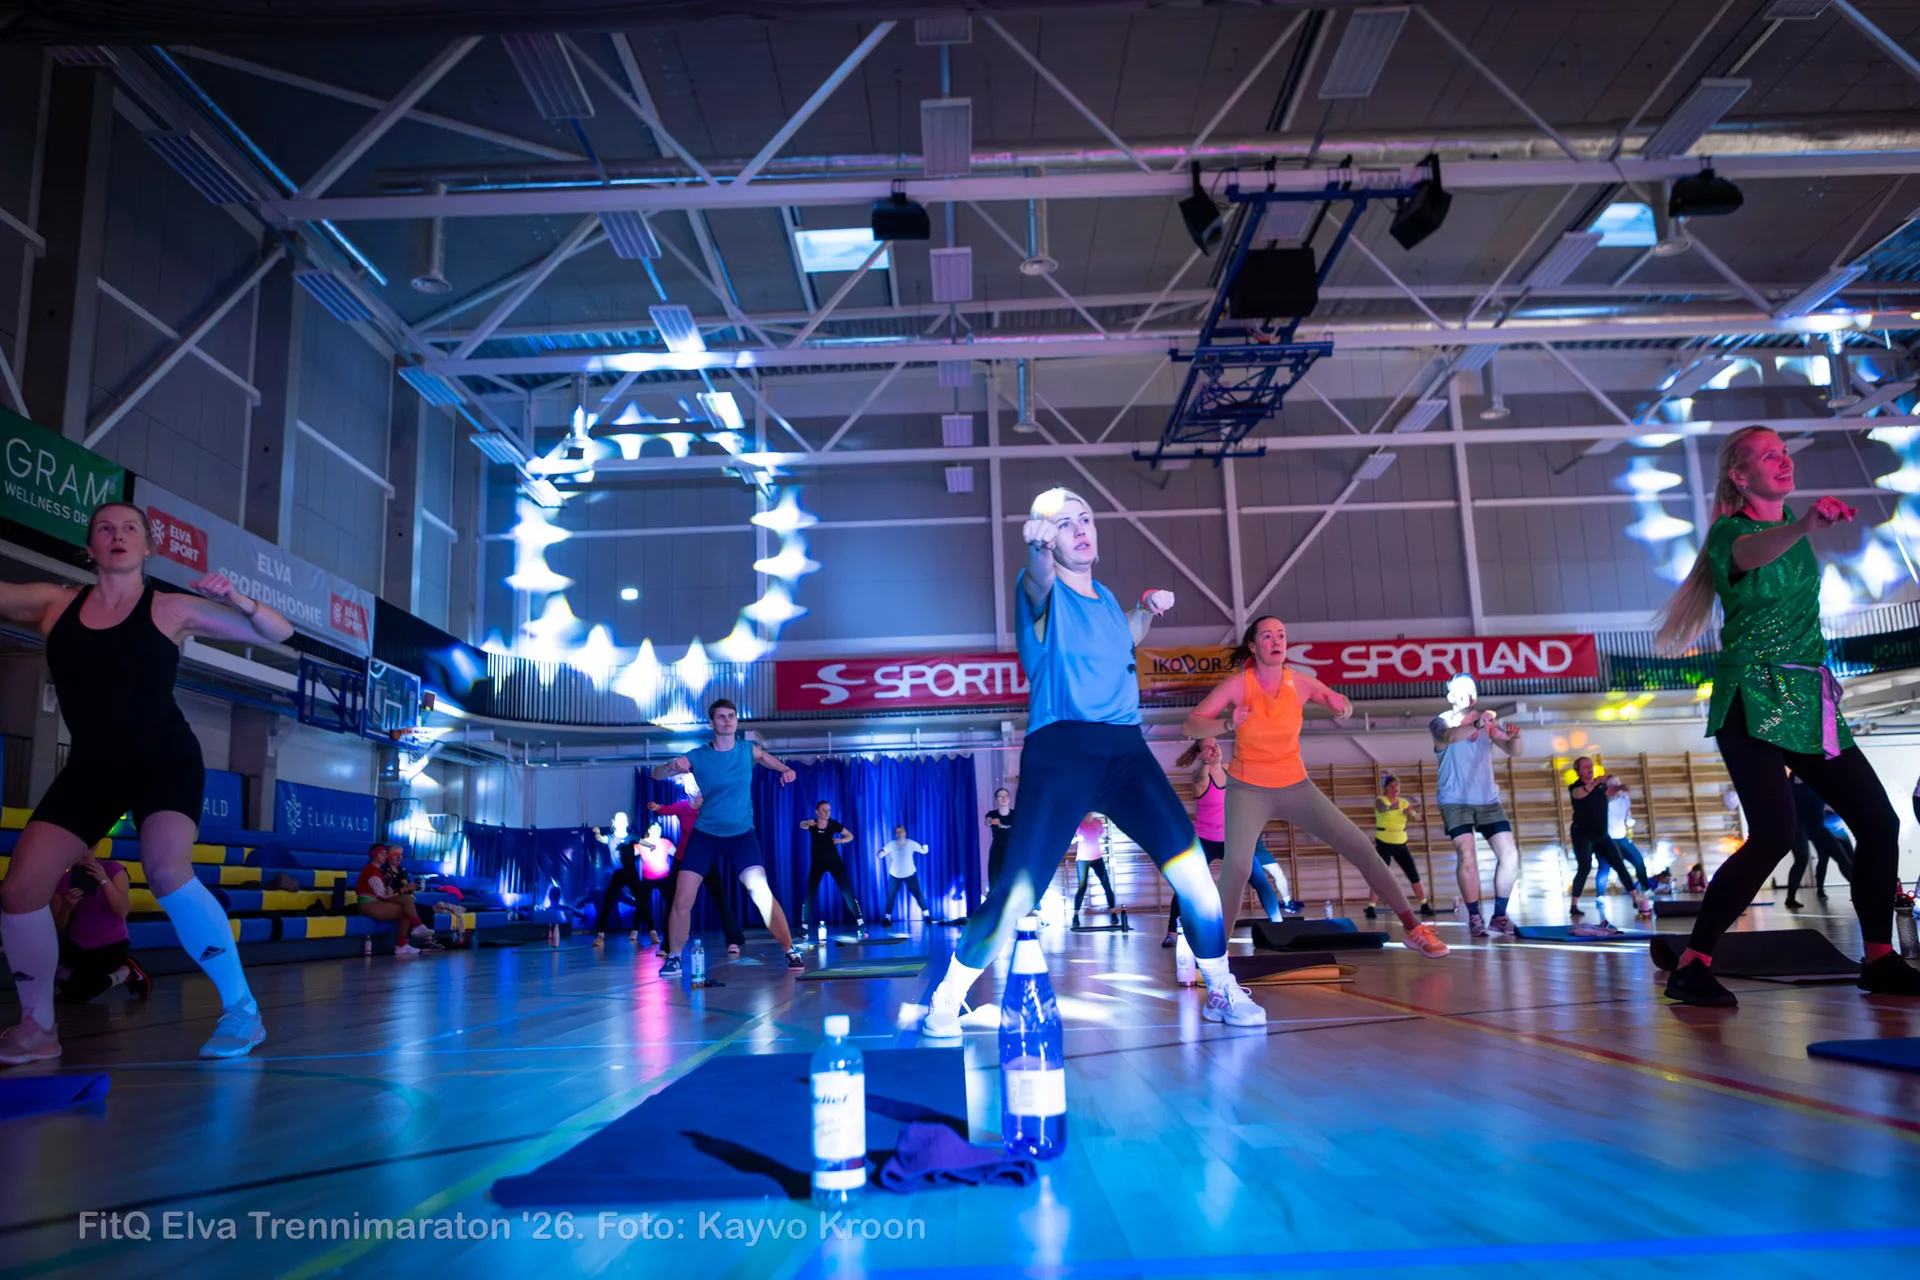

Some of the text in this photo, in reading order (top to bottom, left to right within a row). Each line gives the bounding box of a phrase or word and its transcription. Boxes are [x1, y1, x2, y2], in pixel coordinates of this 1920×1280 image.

[4, 480, 71, 520] WELLNESS
[169, 525, 192, 546] ELVA
[169, 540, 200, 563] SPORT
[257, 552, 293, 586] ELVA
[344, 618, 363, 634] SPORT
[1341, 639, 1574, 679] SPORTLAND
[202, 797, 229, 818] ALD
[307, 807, 369, 832] ELVA VALD
